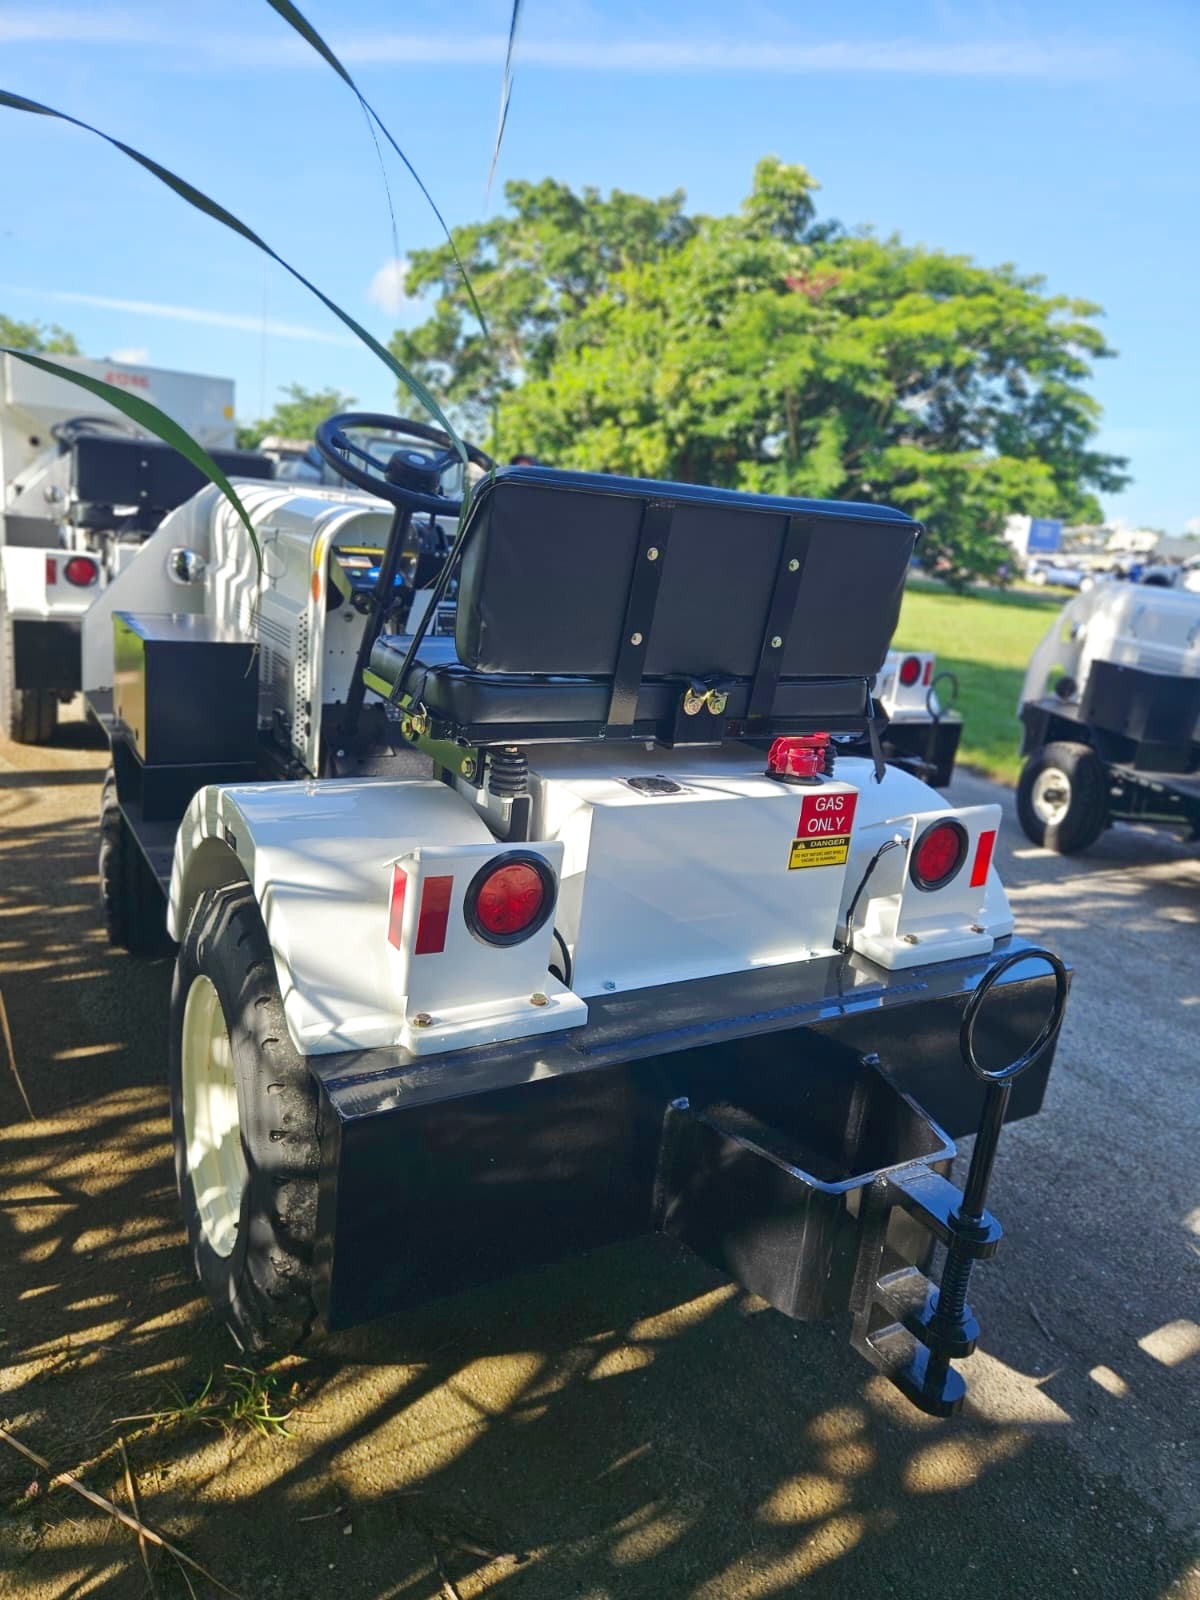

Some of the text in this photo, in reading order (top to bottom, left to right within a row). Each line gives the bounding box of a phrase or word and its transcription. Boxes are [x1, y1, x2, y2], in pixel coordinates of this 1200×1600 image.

[815, 796, 844, 811] GAS
[807, 817, 845, 832] ONLY
[810, 839, 845, 847] DANGER
